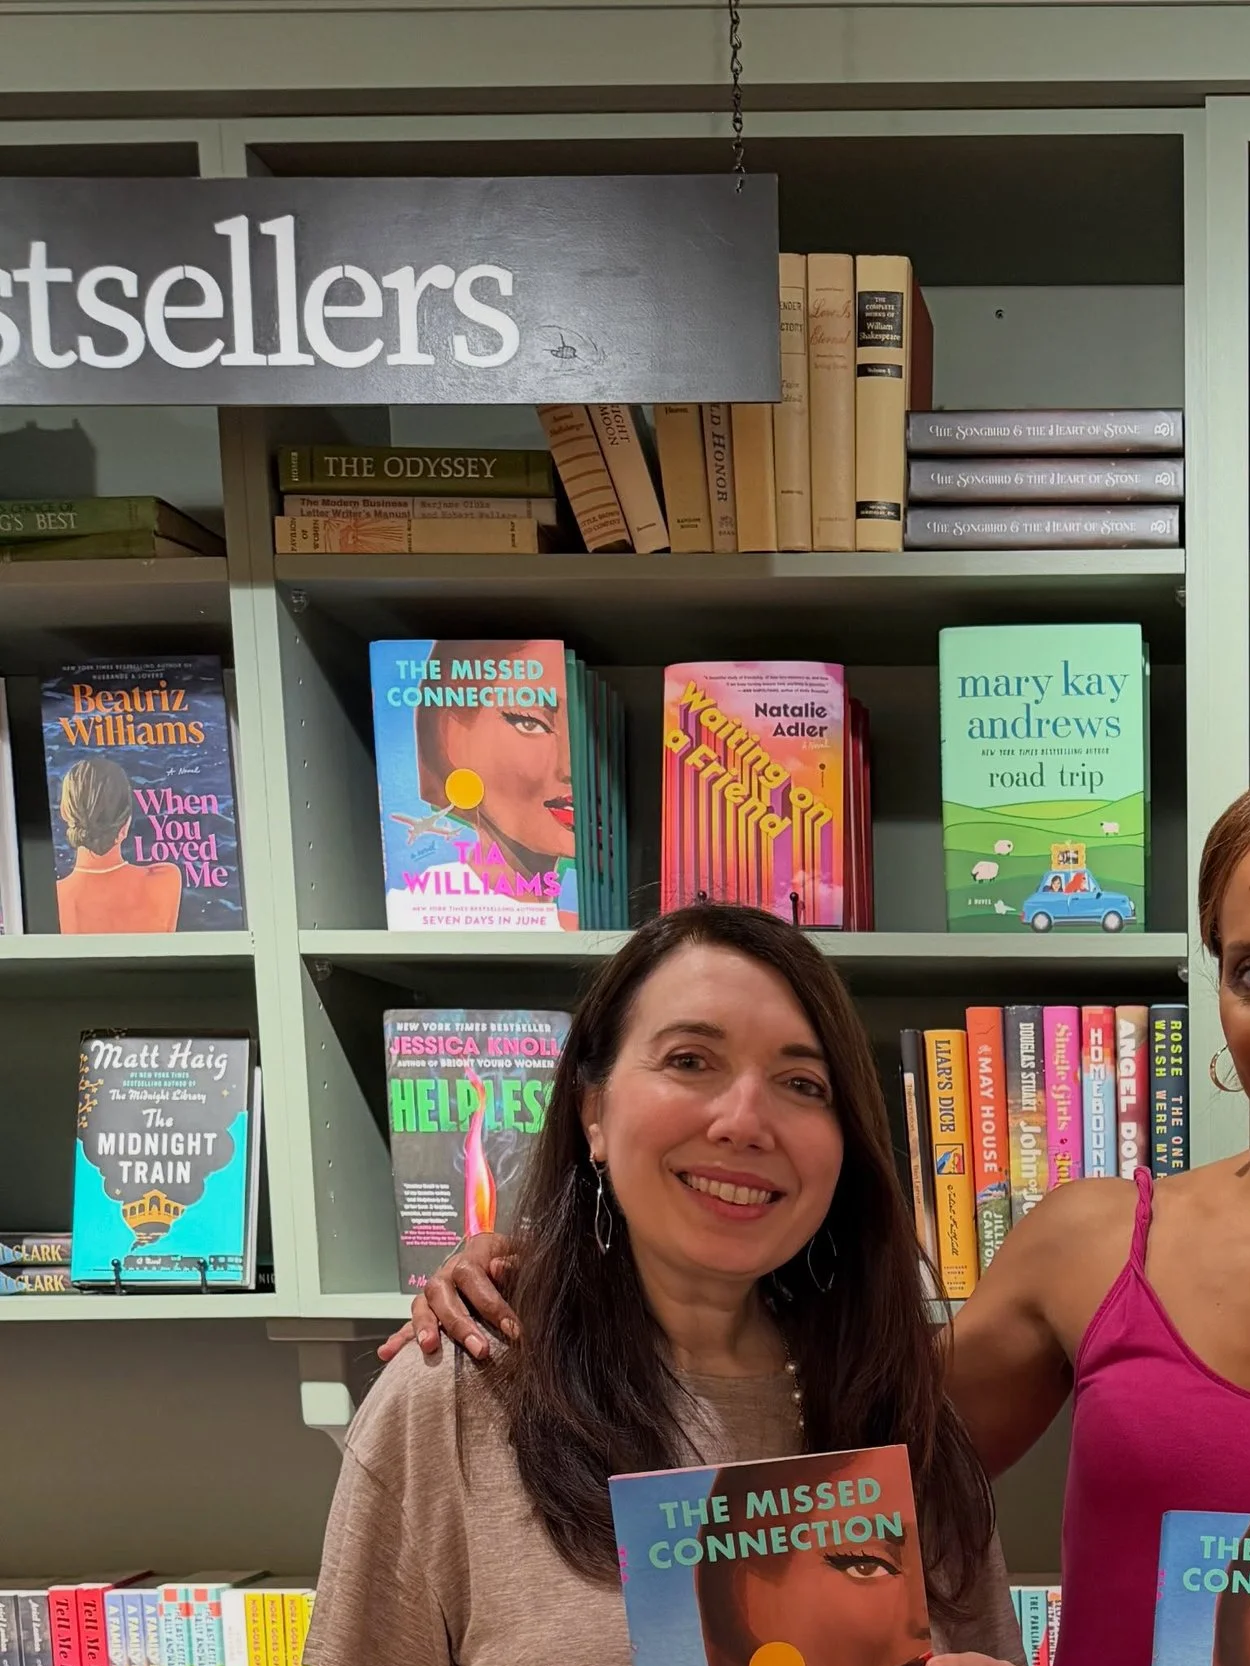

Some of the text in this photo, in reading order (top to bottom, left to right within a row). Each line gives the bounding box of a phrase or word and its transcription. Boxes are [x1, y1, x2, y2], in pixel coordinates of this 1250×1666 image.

[860, 332, 900, 341] Shakespeare
[867, 322, 893, 330] William
[324, 456, 497, 478] THE ODYSSEY
[712, 433, 728, 502] HONOR
[36, 513, 78, 530] BEST
[396, 660, 543, 680] THE MISSED
[957, 660, 1130, 704] mary kay
[73, 680, 188, 715] Beatriz
[387, 687, 557, 707] CONNECTION
[754, 701, 829, 720] Natalie
[61, 713, 205, 747] Williams
[772, 720, 829, 740] Adler
[967, 703, 1123, 741] andrews
[679, 680, 834, 831] Waiting on
[665, 729, 792, 841] a Friend
[988, 761, 1104, 794] road trip
[134, 788, 219, 817] When
[148, 814, 201, 842] You
[135, 835, 219, 864] Loved
[453, 841, 506, 866] TIA
[185, 862, 229, 888] Me
[402, 872, 561, 896] WILLIAMS
[90, 1040, 228, 1081] Matt Haig
[390, 1036, 560, 1057] JESSICA KNOLL
[1118, 1019, 1137, 1113] ANGEL
[1154, 1020, 1167, 1135] WALSH WERE
[935, 1039, 955, 1132] LIAR'S DICE
[1019, 1022, 1043, 1178] DOUGLAS STUART John
[1170, 1020, 1183, 1168] ROSIE THE ONE
[142, 1108, 174, 1128] The
[978, 1060, 997, 1173] MAY HOUSE
[97, 1132, 217, 1156] MIDNIGHT
[119, 1161, 191, 1184] TRAIN
[660, 1478, 881, 1529] THE MISSED
[648, 1512, 903, 1569] CONNECTION
[55, 1599, 72, 1633] Tell
[57, 1635, 72, 1660] Me
